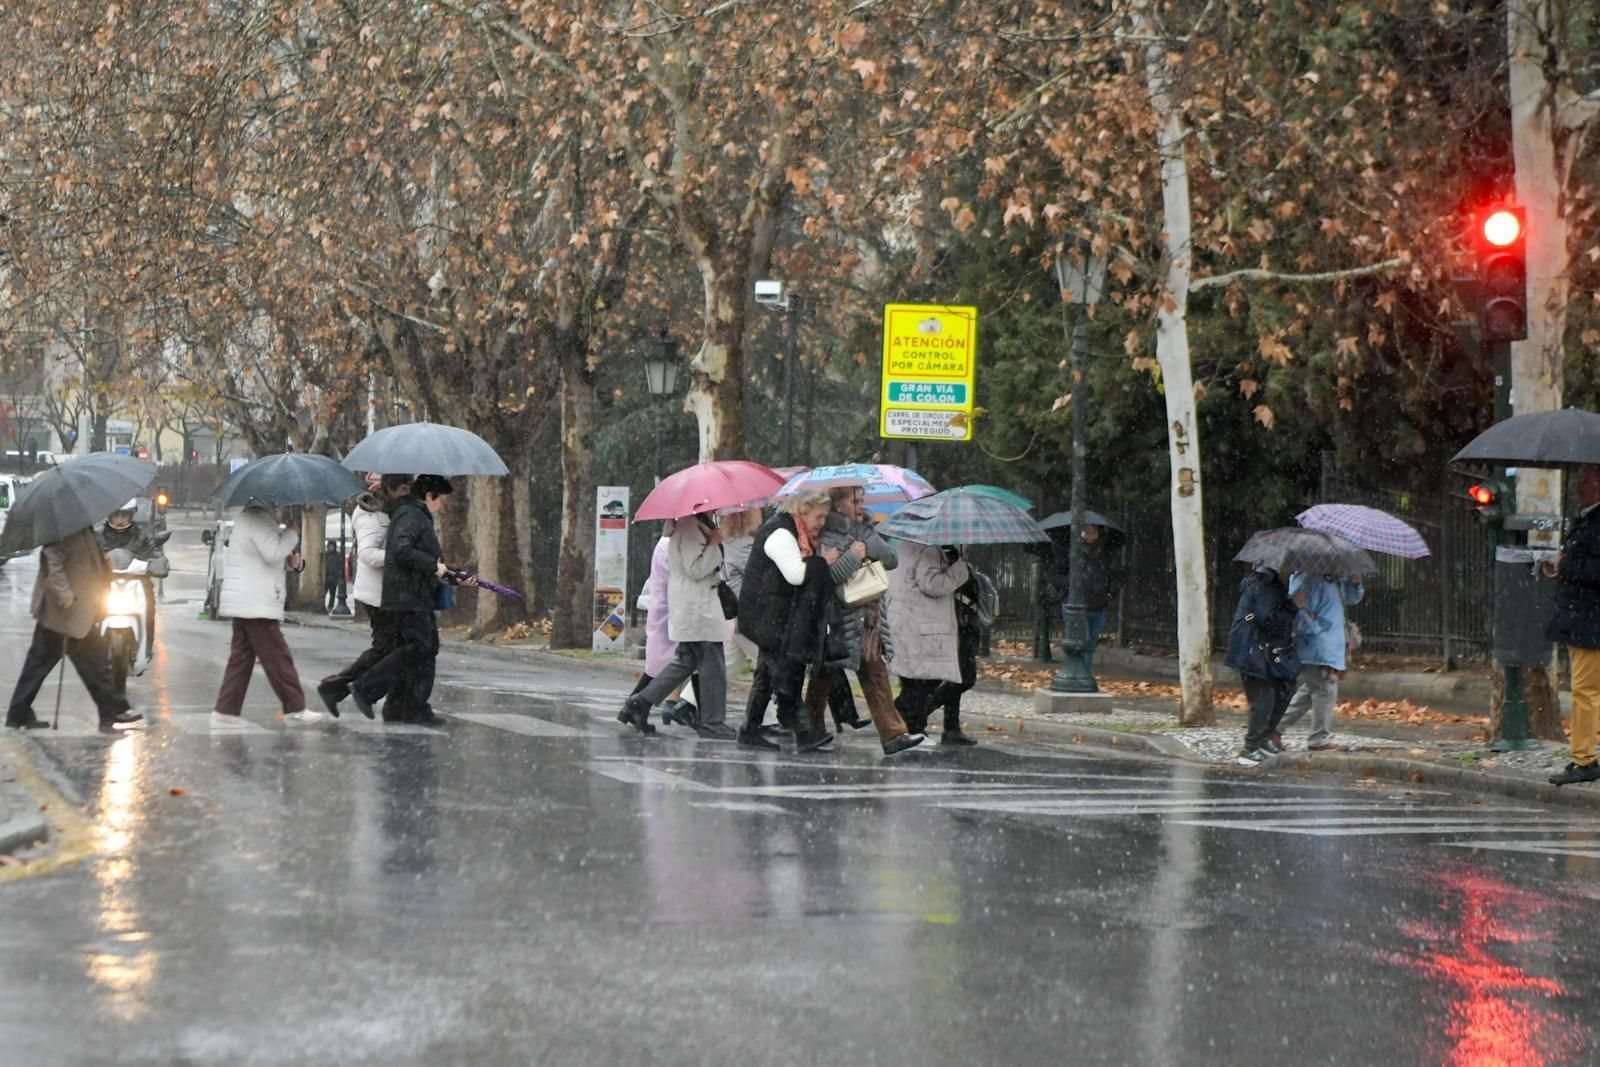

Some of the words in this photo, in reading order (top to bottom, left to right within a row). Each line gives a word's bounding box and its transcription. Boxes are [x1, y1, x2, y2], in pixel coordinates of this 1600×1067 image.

[893, 335, 965, 349] ATENCIÓN
[902, 351, 956, 361] CONTROL
[891, 361, 913, 370] POR
[917, 361, 965, 371] CÁMARA
[900, 383, 932, 393] GRAN
[898, 393, 913, 402] DE
[887, 411, 910, 419] CARRIL
[901, 427, 950, 435] PROTEGIDO
